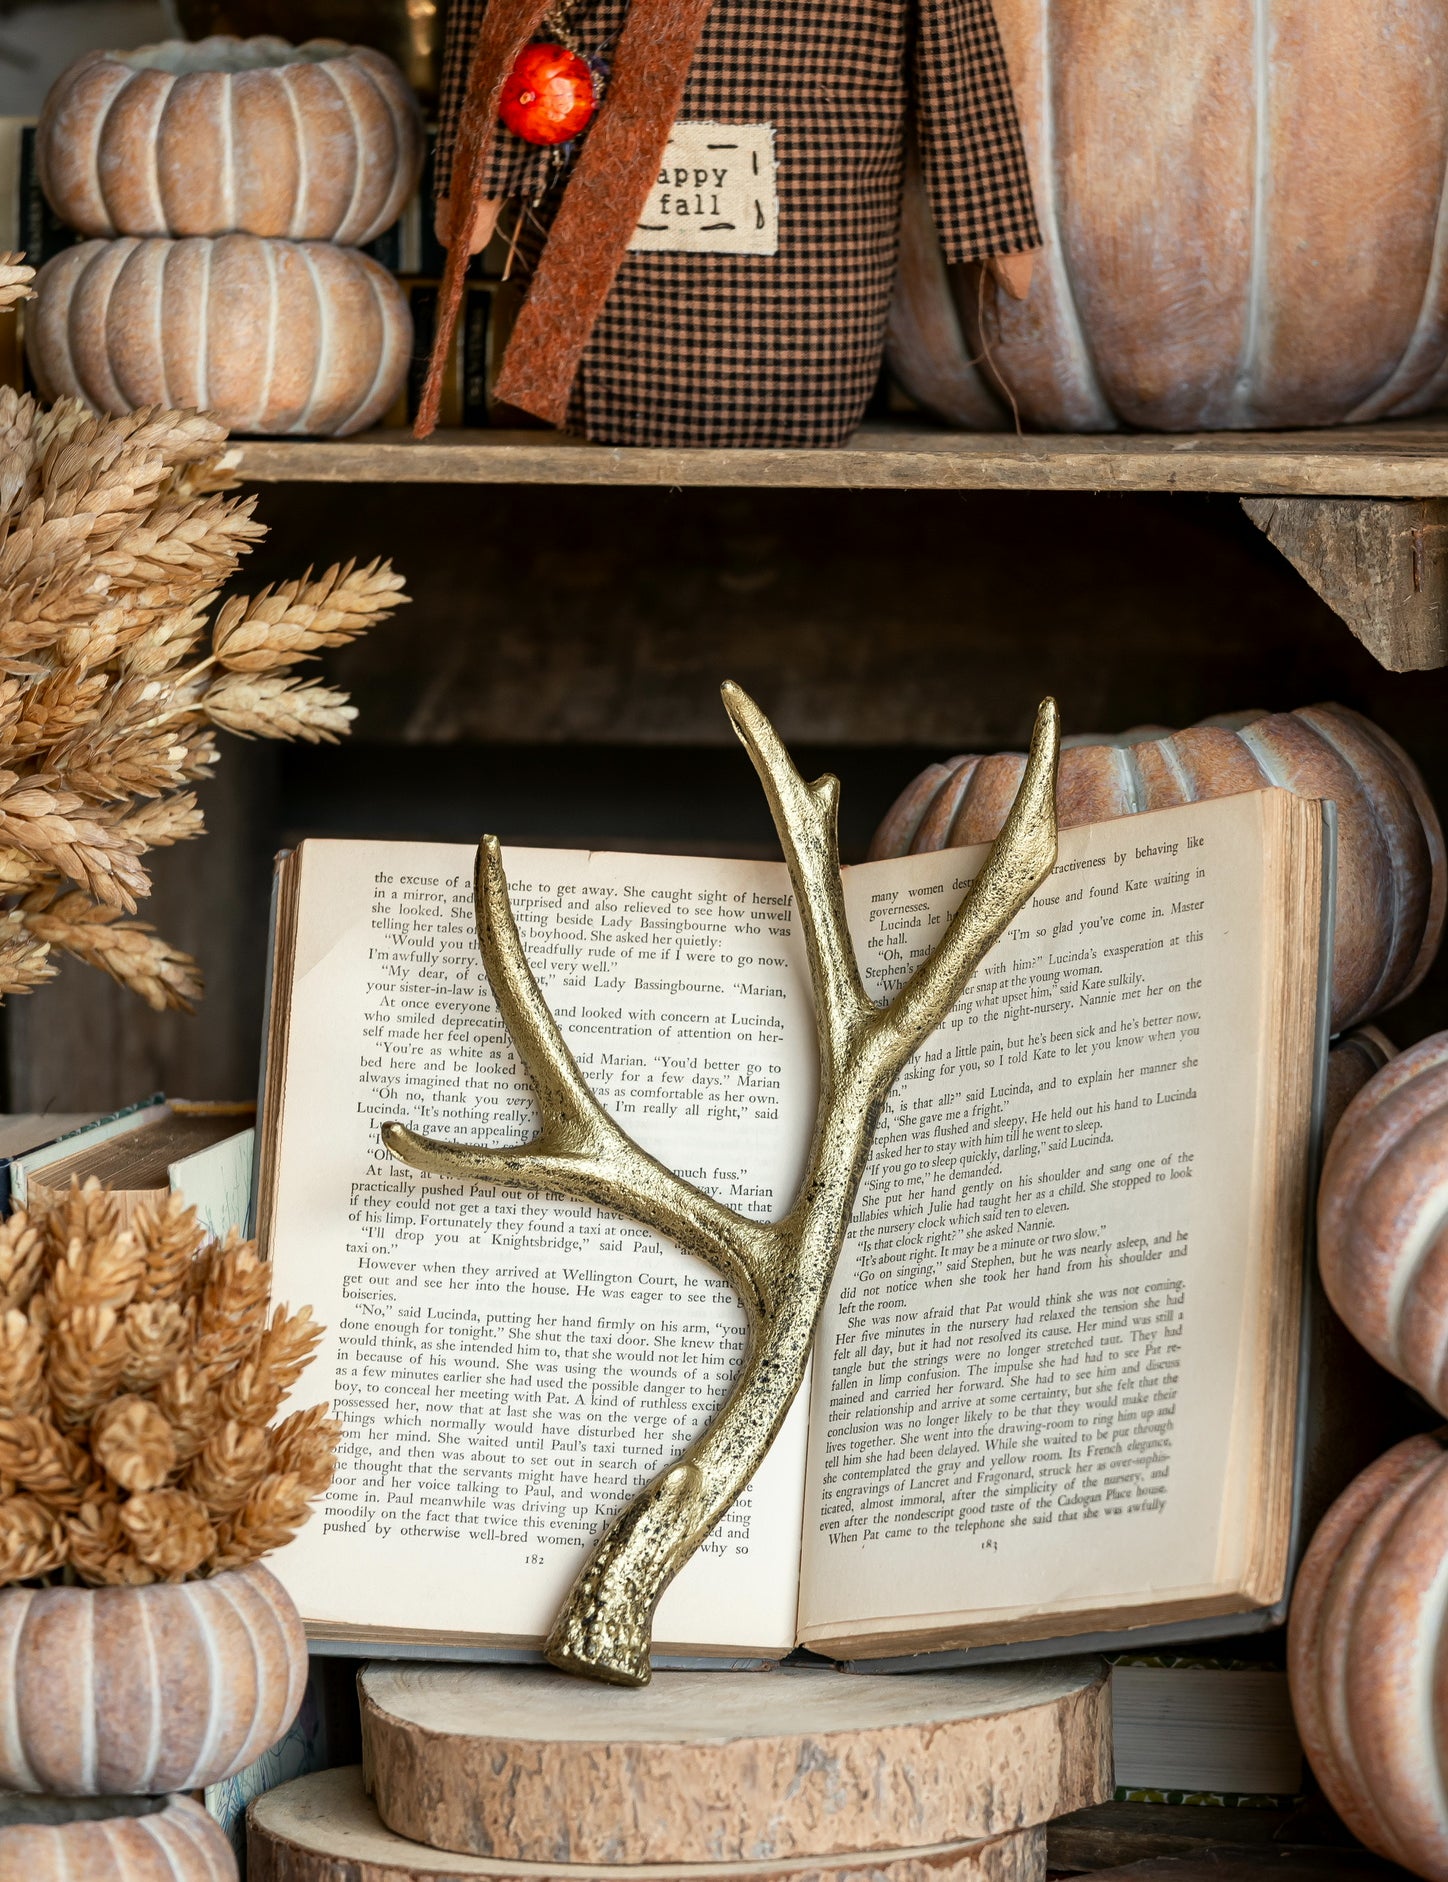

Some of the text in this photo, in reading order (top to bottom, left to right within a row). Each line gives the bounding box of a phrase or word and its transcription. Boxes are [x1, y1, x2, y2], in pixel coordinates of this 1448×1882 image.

[656, 167, 728, 188] appy
[659, 193, 721, 216] fall
[1113, 836, 1204, 864] by behaving like
[374, 871, 793, 906] the excuse of to get away. She caught sight of herself
[1032, 866, 1205, 907] house and found Kate waiting in
[869, 903, 929, 921] governesses.
[371, 917, 721, 949] telling her tales boyhood. She asked her quietly:
[392, 950, 439, 966] awfully
[441, 956, 478, 968] sorry.
[984, 961, 1006, 975] with
[1103, 939, 1163, 957] exasperation
[1169, 936, 1179, 946] at
[1185, 930, 1203, 942] this
[562, 972, 586, 986] said
[594, 976, 625, 991] Lady
[634, 978, 723, 994] Bassingbourne.
[379, 995, 784, 1029] At once everyone and looked with concern at Lucinda,
[568, 1024, 783, 1042] concentration of attention on her-
[357, 1101, 409, 1115] Lucinda.
[442, 1106, 489, 1123] nothing
[861, 1151, 1194, 1207] She put her hand gently on his shoulder and sang one of the
[893, 1173, 905, 1187] to
[932, 1171, 945, 1182] he
[948, 1163, 1002, 1179] demanded.
[348, 1209, 654, 1237] of his limp. Fortunately they found a taxi at once.
[873, 1238, 893, 1250] that
[895, 1232, 923, 1247] clock
[965, 1227, 983, 1239] she
[985, 1222, 1013, 1236] asked
[1016, 1218, 1055, 1232] Nannie.
[394, 1227, 424, 1244] drop
[434, 1234, 458, 1245] you
[468, 1235, 481, 1244] at
[599, 1239, 622, 1251] said
[633, 1241, 662, 1255] Paul,
[342, 1285, 396, 1300] boiseries.
[838, 1299, 906, 1314] left the room.
[397, 1306, 421, 1318] said
[427, 1307, 480, 1322] Lucinda,
[486, 1312, 531, 1327] putting
[536, 1313, 557, 1326] her
[561, 1315, 591, 1327] hand
[597, 1317, 635, 1333] firmly
[639, 1322, 655, 1330] on
[660, 1320, 678, 1332] his
[682, 1324, 709, 1334] arm,
[824, 1431, 1077, 1468] tell him she had been delayed. While she waited
[819, 1494, 1052, 1530] even after the nondescript good taste of the
[322, 1521, 585, 1549] pushed by otherwise well-bred women,
[828, 1511, 1052, 1543] When Pat came to the telephone she said
[525, 1553, 543, 1564] 182
